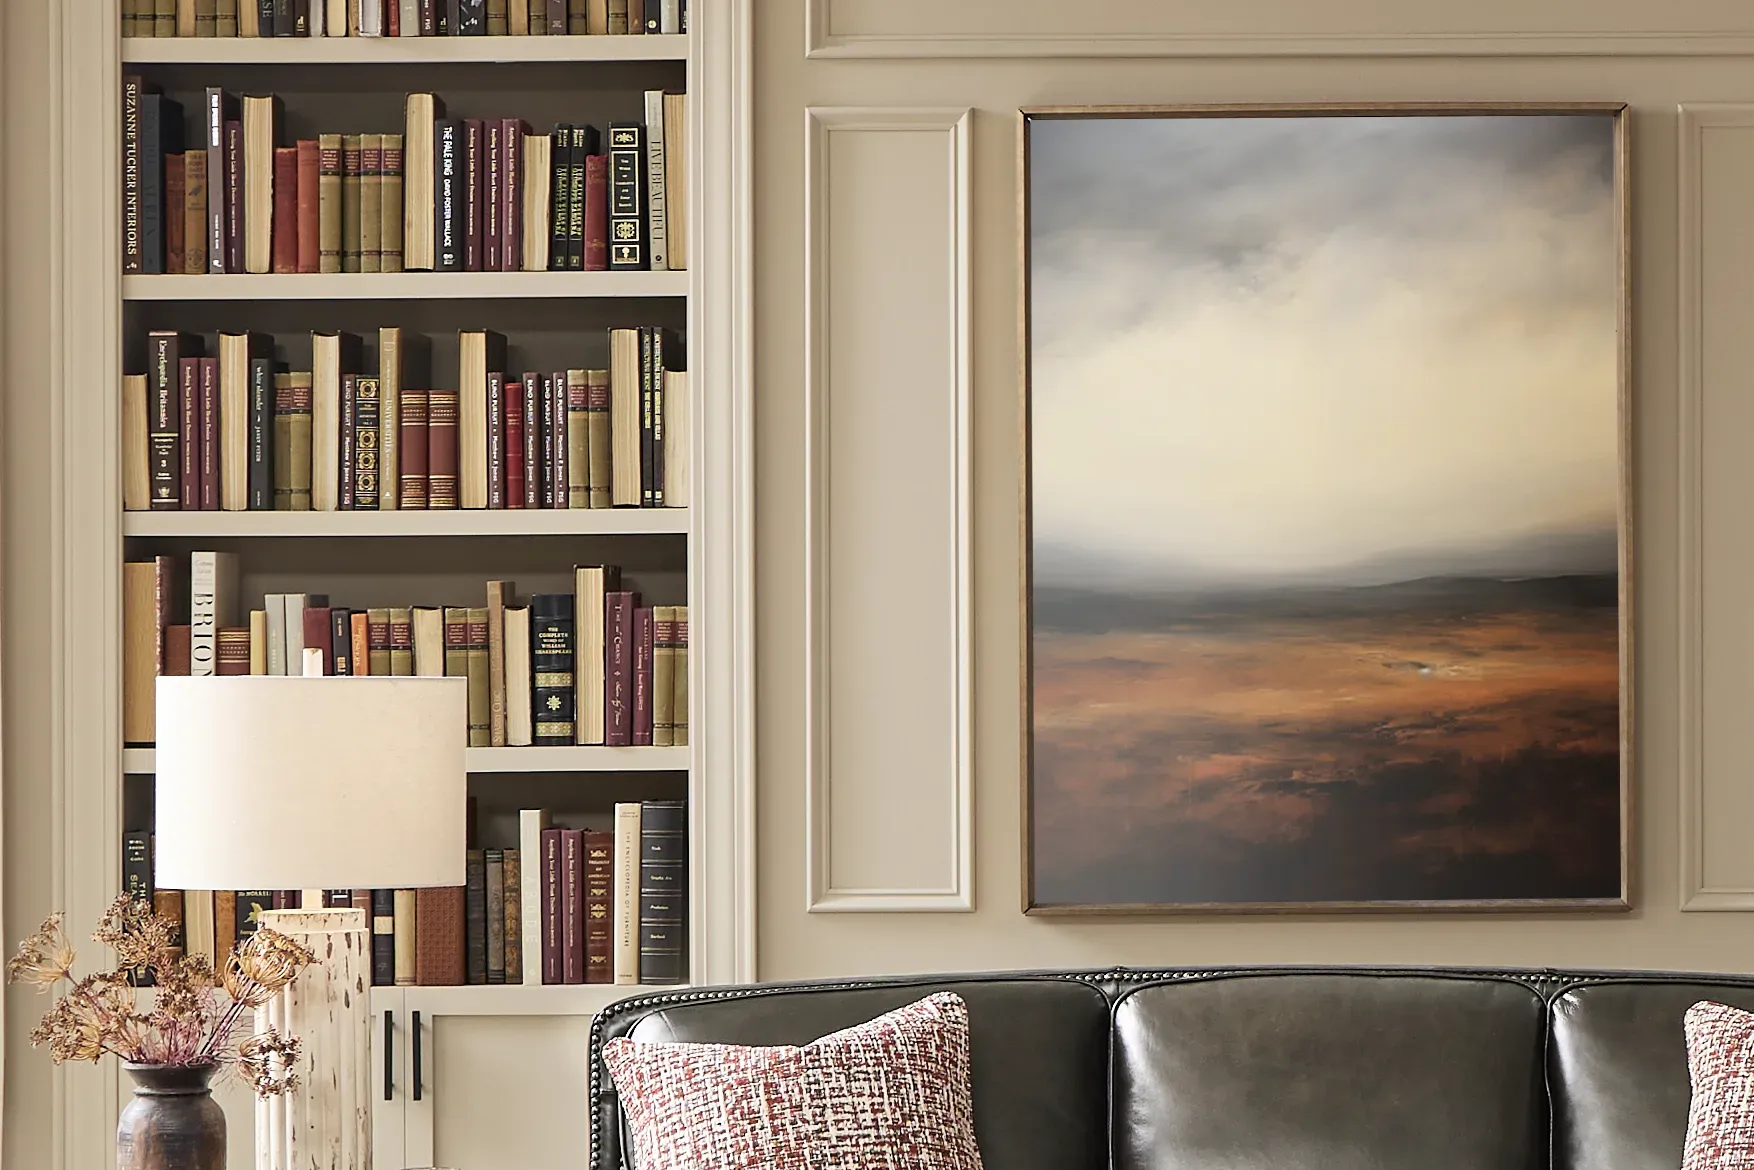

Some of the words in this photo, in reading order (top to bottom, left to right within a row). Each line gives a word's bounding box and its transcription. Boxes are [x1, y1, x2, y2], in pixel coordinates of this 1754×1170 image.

[126, 84, 136, 139] SUZANNE
[442, 127, 453, 140] THE
[442, 141, 453, 158] PALE
[126, 142, 137, 188] TUCKER
[443, 159, 454, 175] KING
[650, 141, 662, 173] LIVE
[127, 192, 137, 254] INTERIORS
[651, 174, 664, 244] BEAUTIFUL
[443, 220, 452, 247] WALLACE
[193, 593, 213, 676] BRIO
